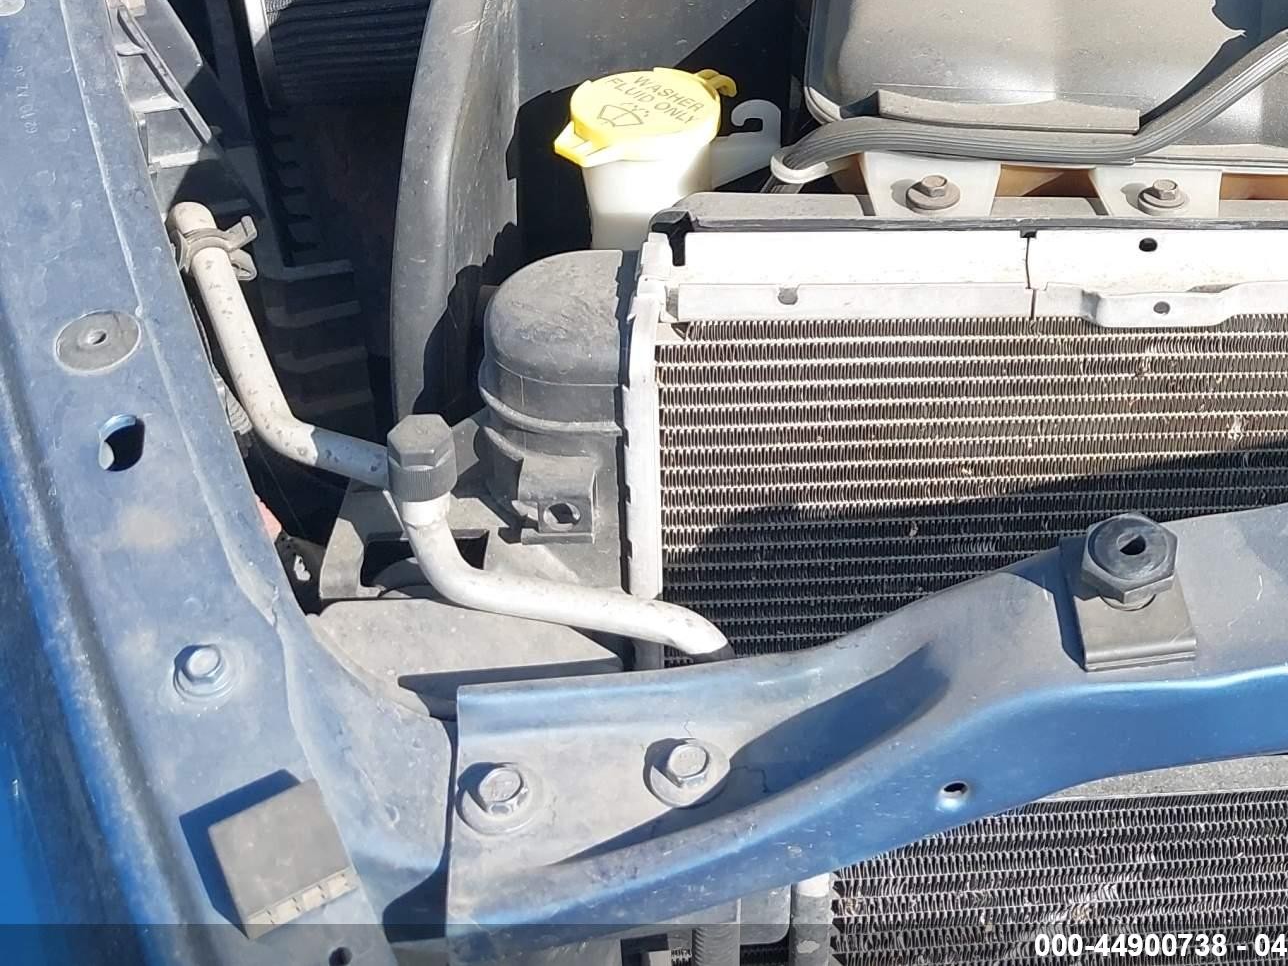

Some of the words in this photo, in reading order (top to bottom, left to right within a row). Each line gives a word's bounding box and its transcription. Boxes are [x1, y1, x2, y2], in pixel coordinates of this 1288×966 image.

[607, 77, 656, 104] FLUID
[654, 101, 699, 124] ONLY
[633, 76, 704, 113] WASHER
